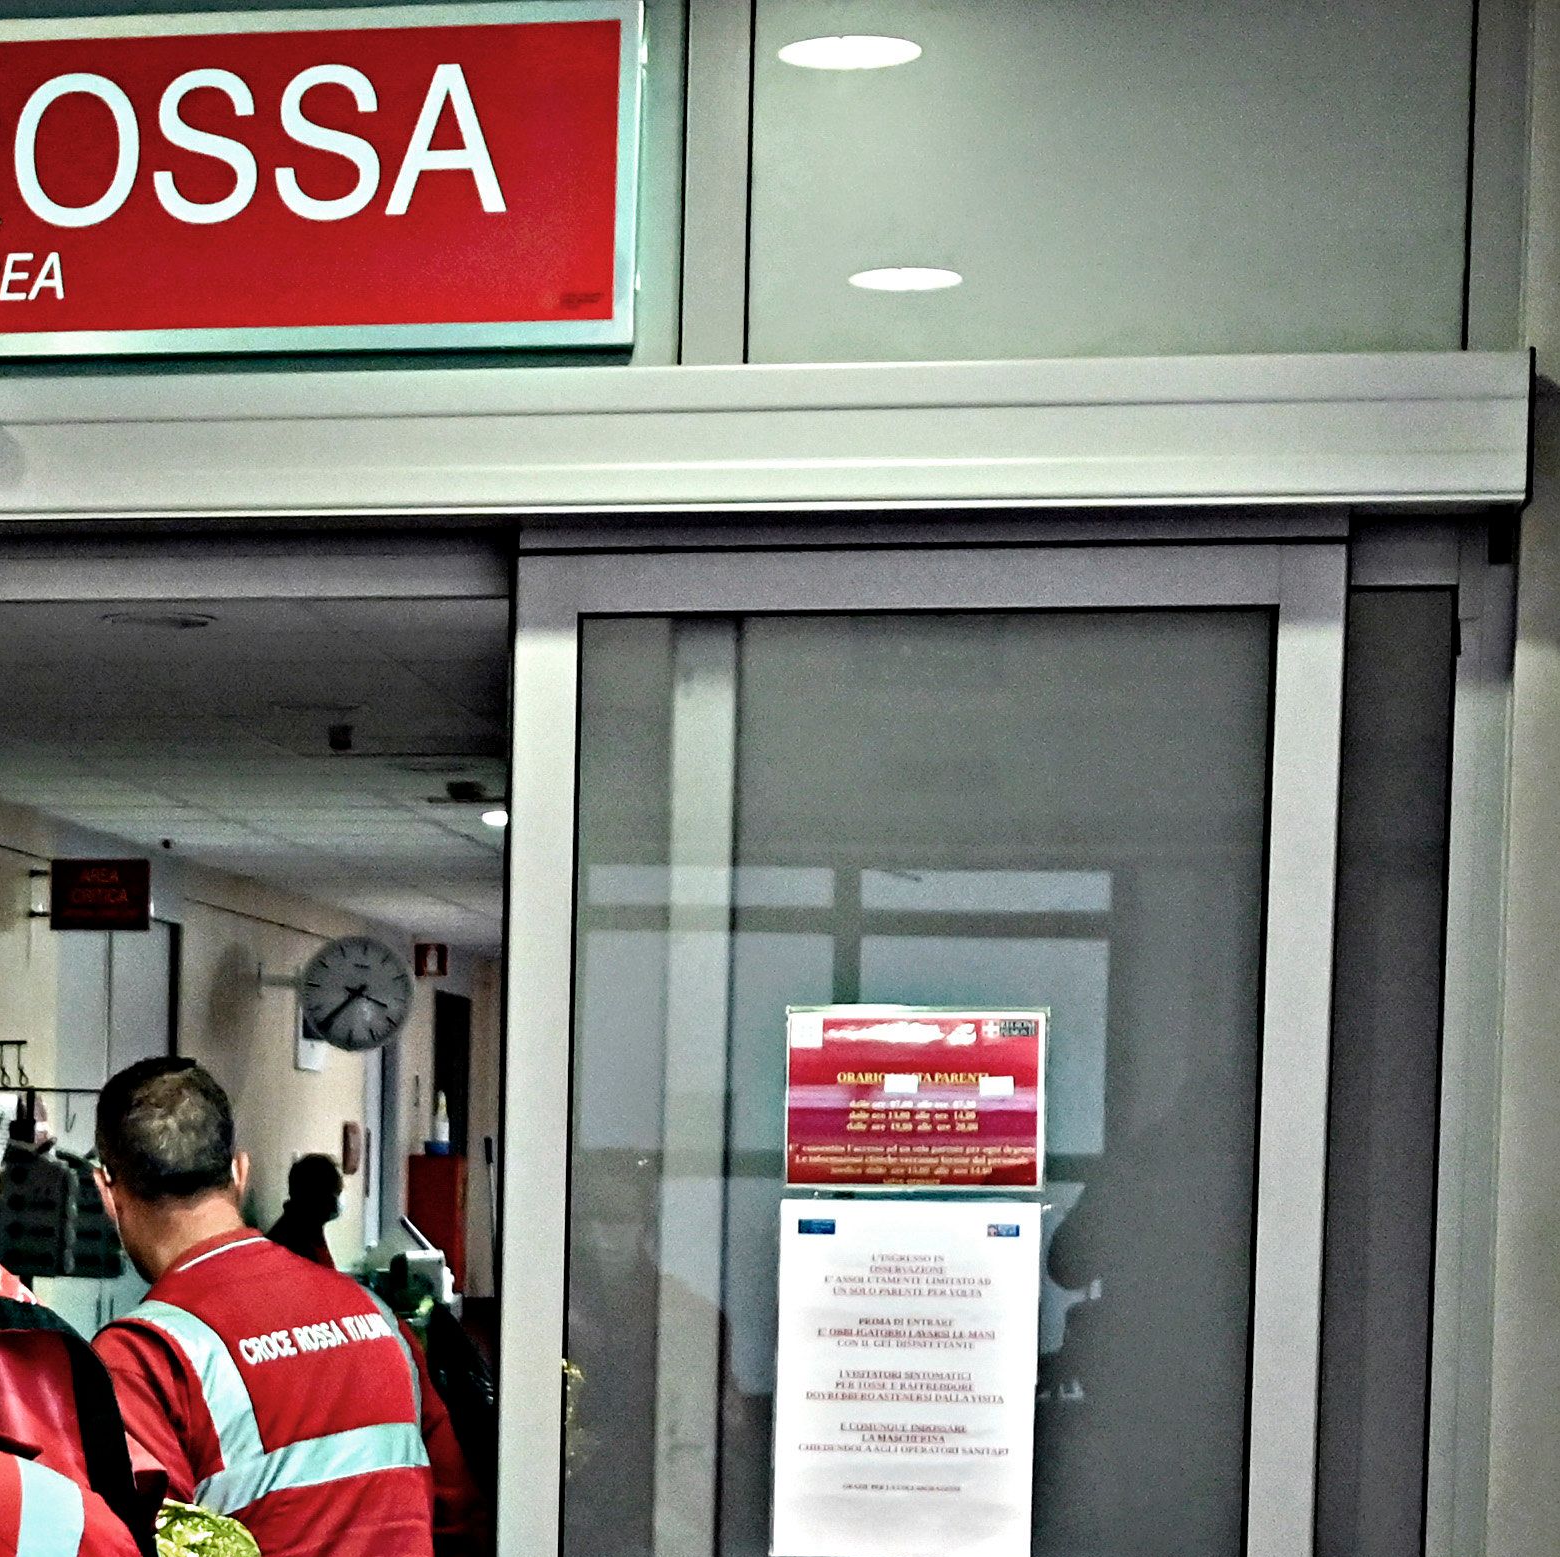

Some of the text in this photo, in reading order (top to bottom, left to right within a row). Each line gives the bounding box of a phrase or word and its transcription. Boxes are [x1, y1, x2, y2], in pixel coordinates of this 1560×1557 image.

[935, 1072, 989, 1083] PARENT
[239, 1331, 297, 1365] CROCE
[292, 1320, 349, 1353] ROSSA
